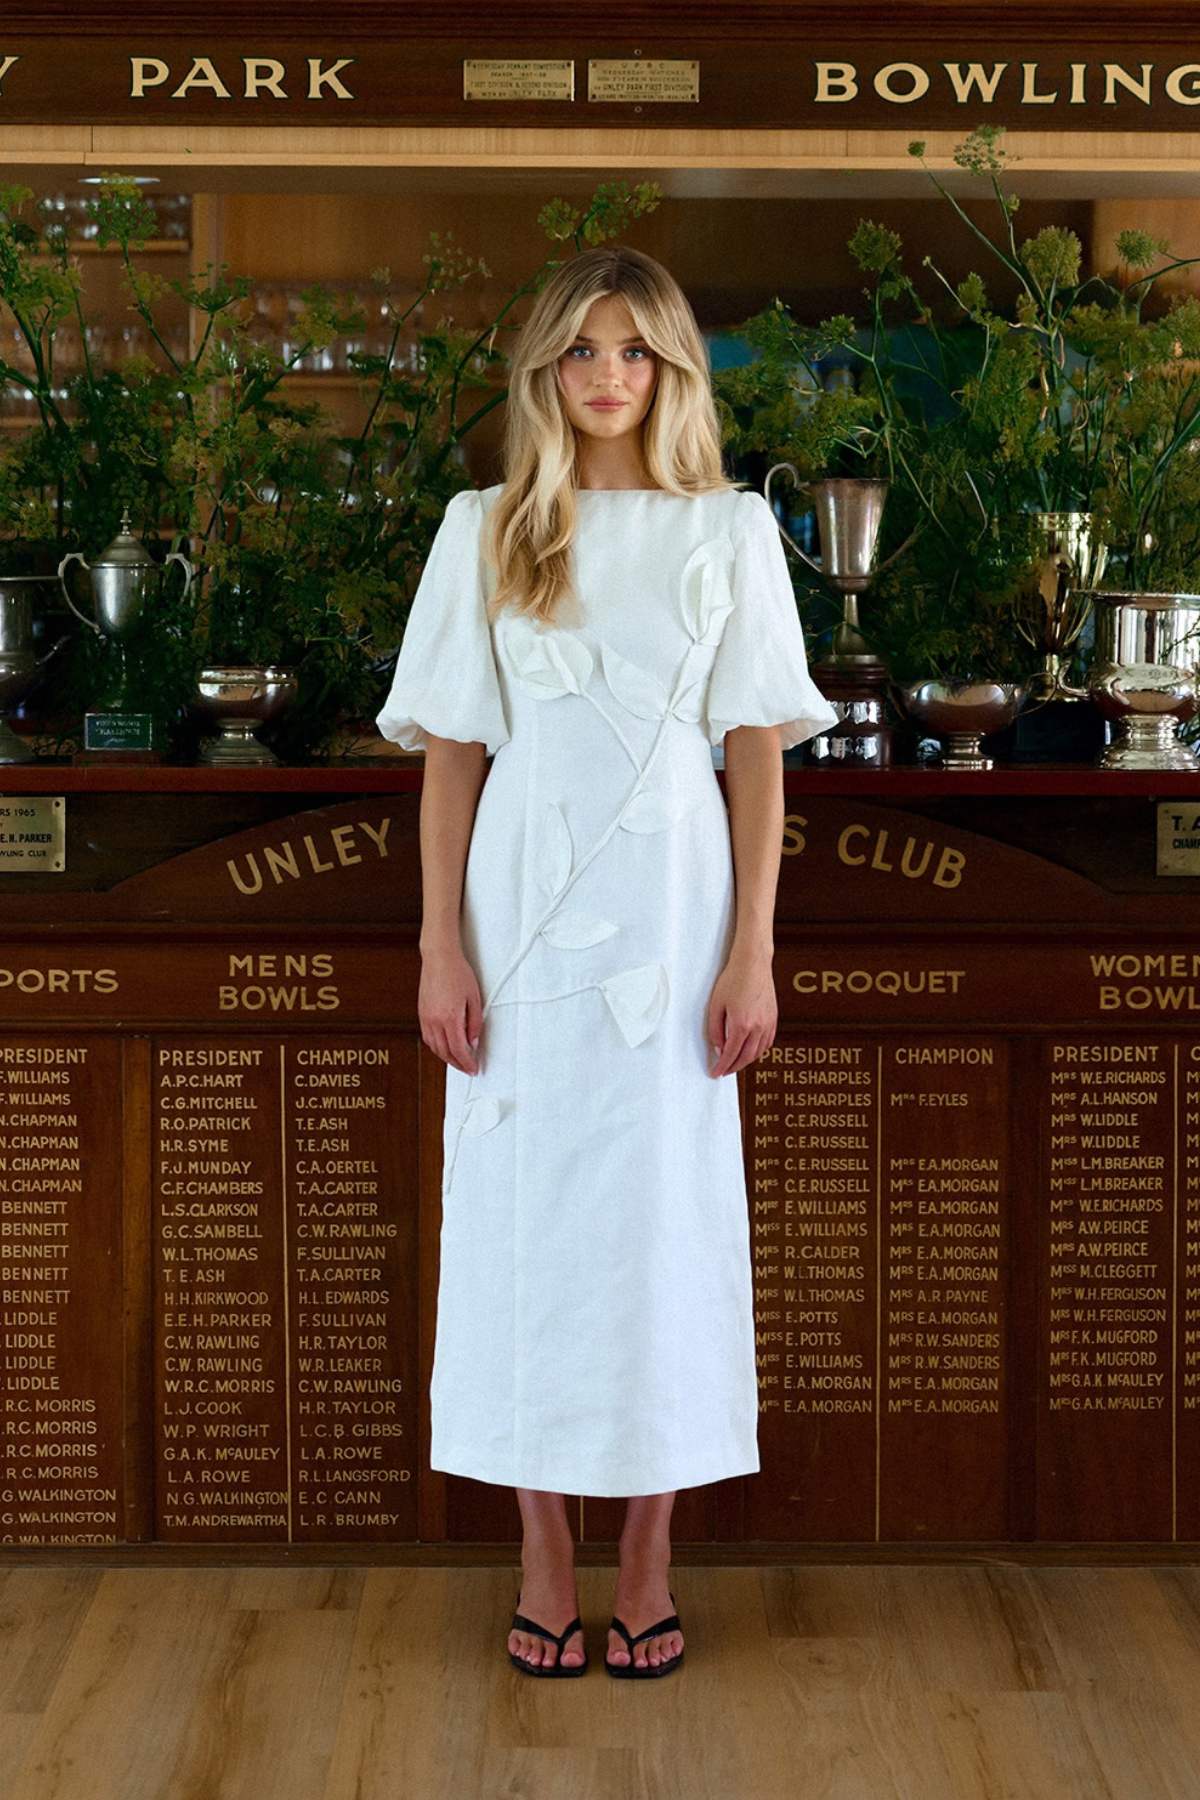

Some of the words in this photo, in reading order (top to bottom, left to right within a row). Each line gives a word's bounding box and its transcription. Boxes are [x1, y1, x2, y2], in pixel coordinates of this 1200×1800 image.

[131, 58, 353, 98] PARK
[815, 63, 1200, 105] BOWLING
[14, 808, 36, 816] 1965
[19, 833, 52, 843] PARKER
[227, 819, 390, 894] UNLEY
[838, 825, 966, 888] CLUB
[230, 955, 333, 977] MENS
[0, 969, 118, 992] PORTS
[793, 971, 965, 995] CROQUET
[219, 986, 339, 1010] BOWLS
[1100, 986, 1200, 1009] BOWL
[160, 1050, 263, 1066] PRESIDENT
[297, 1049, 388, 1065] CHAMPION
[759, 1048, 862, 1064] PRESIDENT
[896, 1048, 993, 1064] CHAMPION
[1054, 1046, 1158, 1062] PRESIDENT
[2, 1201, 67, 1214] BENNETT
[2, 1223, 68, 1235] BENNETT
[2, 1245, 69, 1258] BENNETT
[2, 1268, 68, 1280] BENNETT
[3, 1290, 70, 1303] BENNETT
